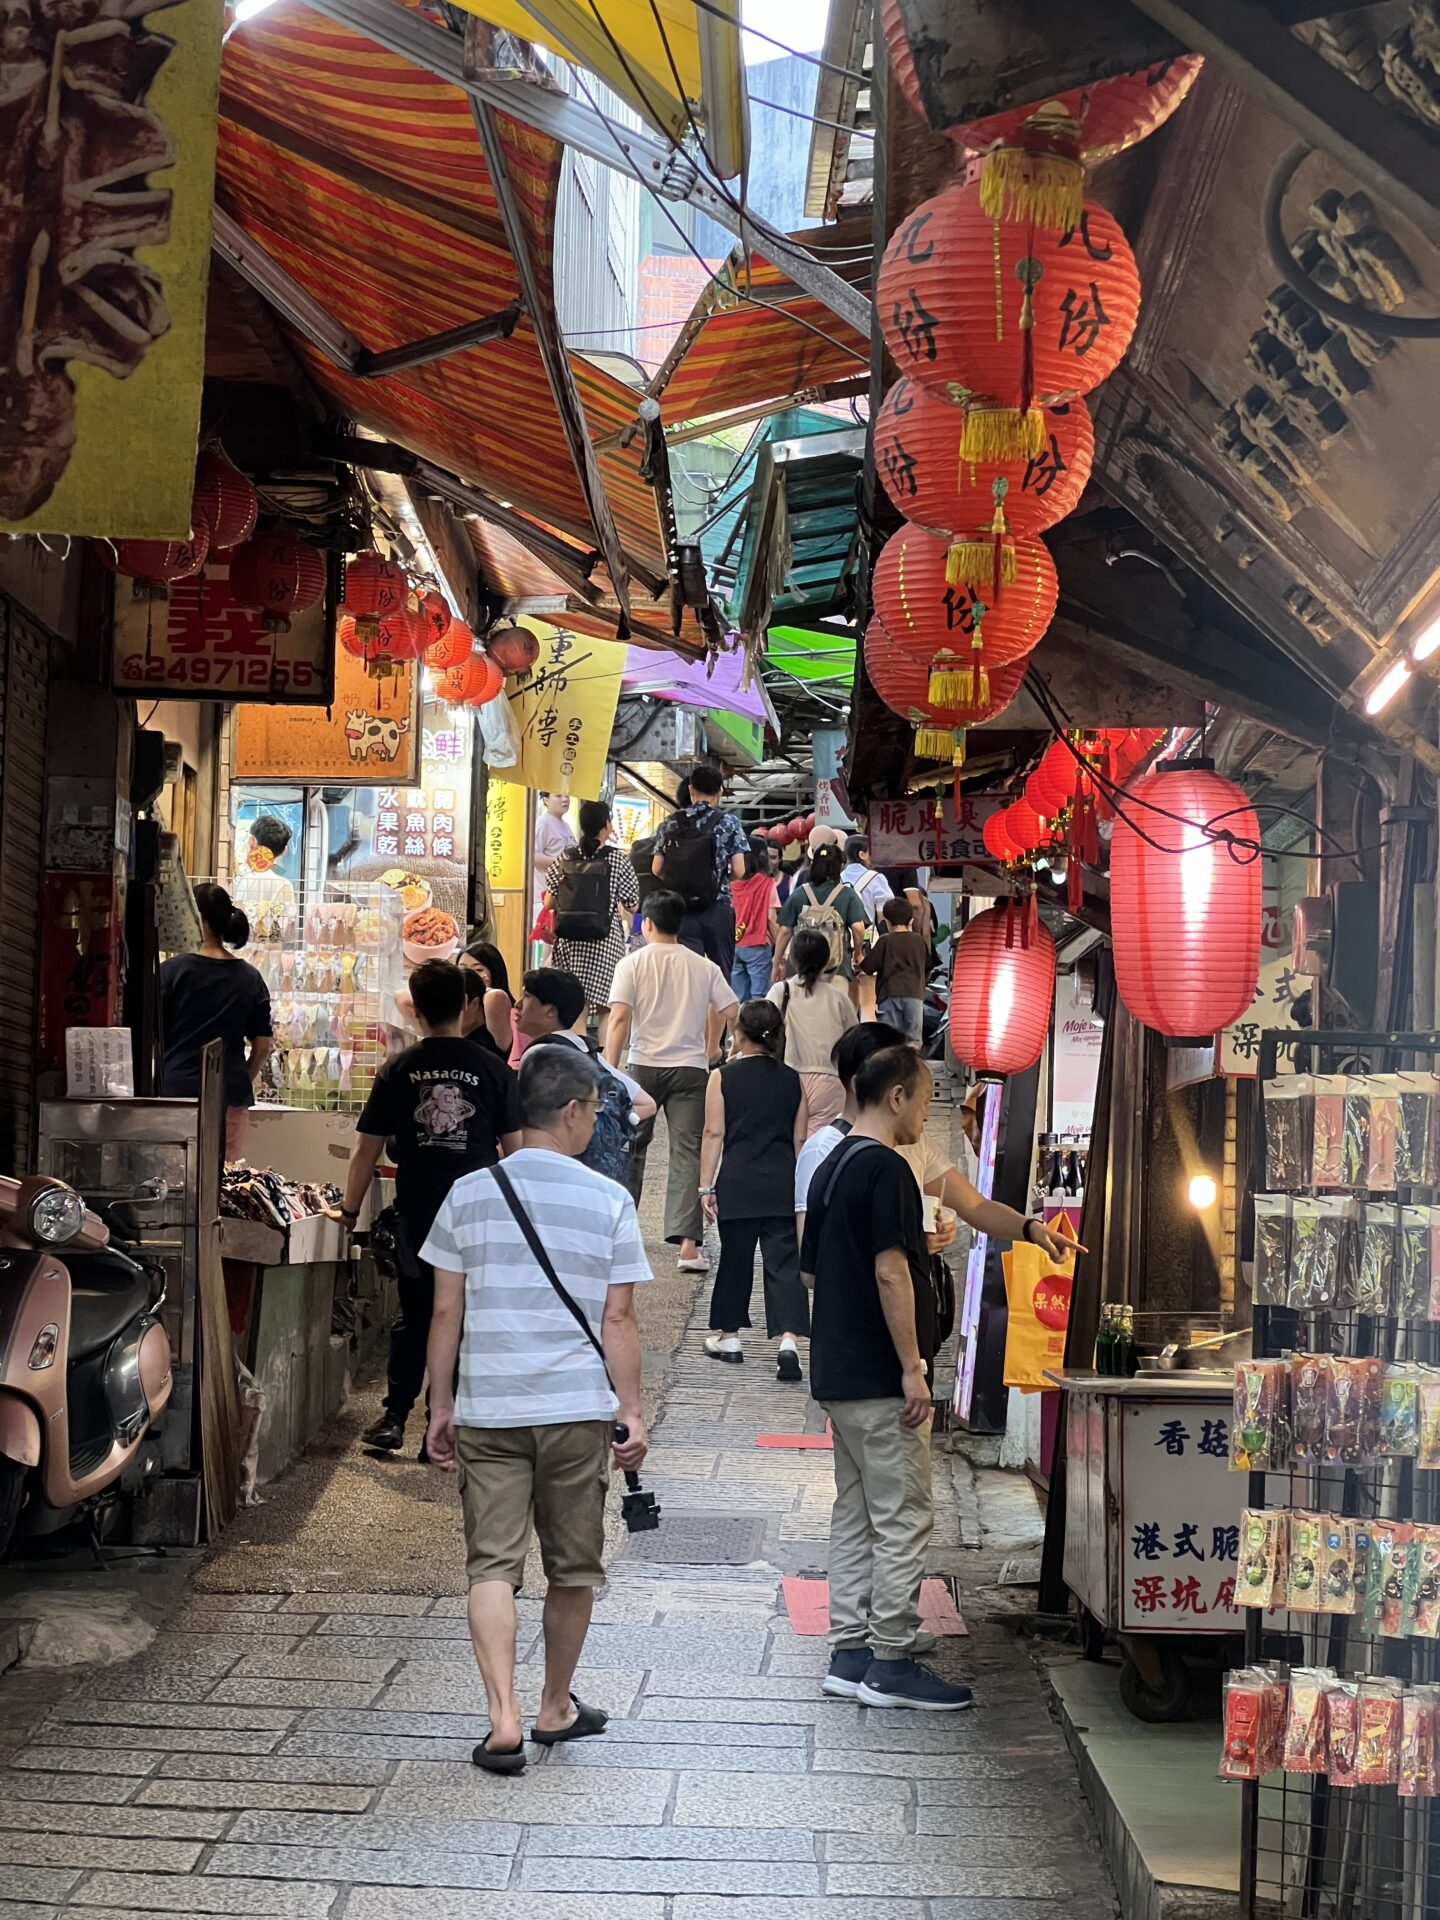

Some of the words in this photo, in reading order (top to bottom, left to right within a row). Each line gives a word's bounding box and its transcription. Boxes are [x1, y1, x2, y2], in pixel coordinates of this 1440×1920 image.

[890, 211, 940, 362] 九份
[1058, 209, 1113, 357] 九份
[1021, 402, 1068, 497] 份
[268, 550, 297, 600] 九份
[378, 562, 395, 607] 九份
[144, 656, 313, 687] 24971255
[450, 665, 465, 692] 山城
[376, 788, 400, 856] 水果乾
[404, 788, 427, 857] 魷魚絲
[1062, 1018, 1087, 1035] Moje
[1033, 1292, 1070, 1312] 果然
[1154, 1419, 1230, 1458] 香菇
[1131, 1522, 1240, 1561] 港式脆
